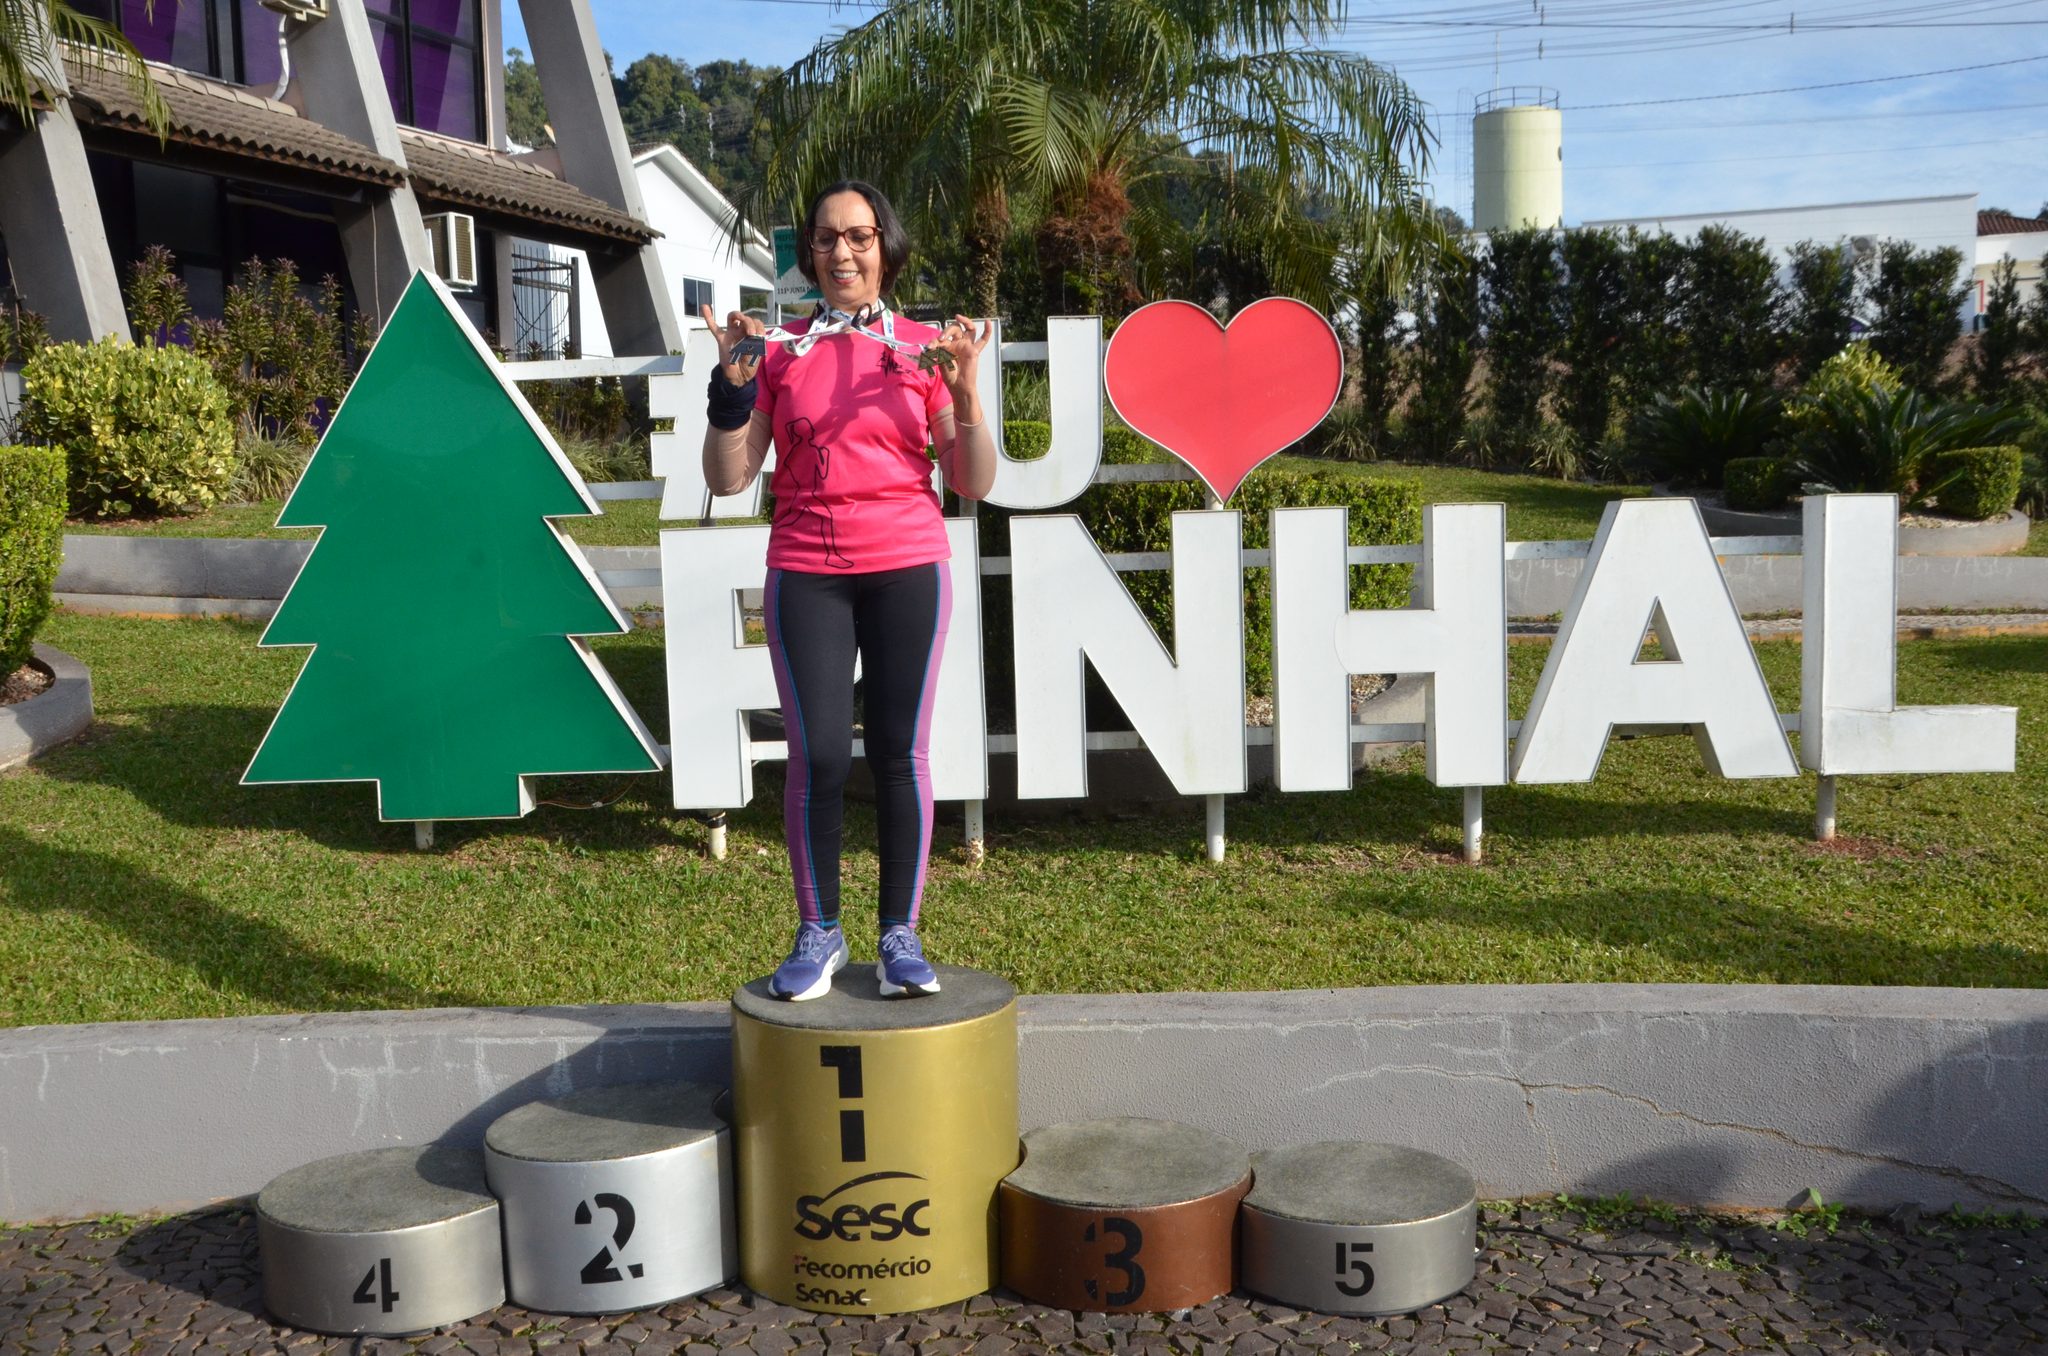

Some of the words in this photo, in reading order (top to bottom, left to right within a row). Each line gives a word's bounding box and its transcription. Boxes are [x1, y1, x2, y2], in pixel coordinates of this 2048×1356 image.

[660, 493, 2017, 810] PINHAL
[820, 1045, 866, 1162] 1
[574, 1192, 644, 1285] 2
[794, 1194, 931, 1242] Sesc
[353, 1258, 399, 1313] 4
[793, 1255, 931, 1279] Fecomércio
[1084, 1217, 1146, 1307] 3
[1335, 1242, 1375, 1297] 5
[796, 1283, 868, 1306] Senac
